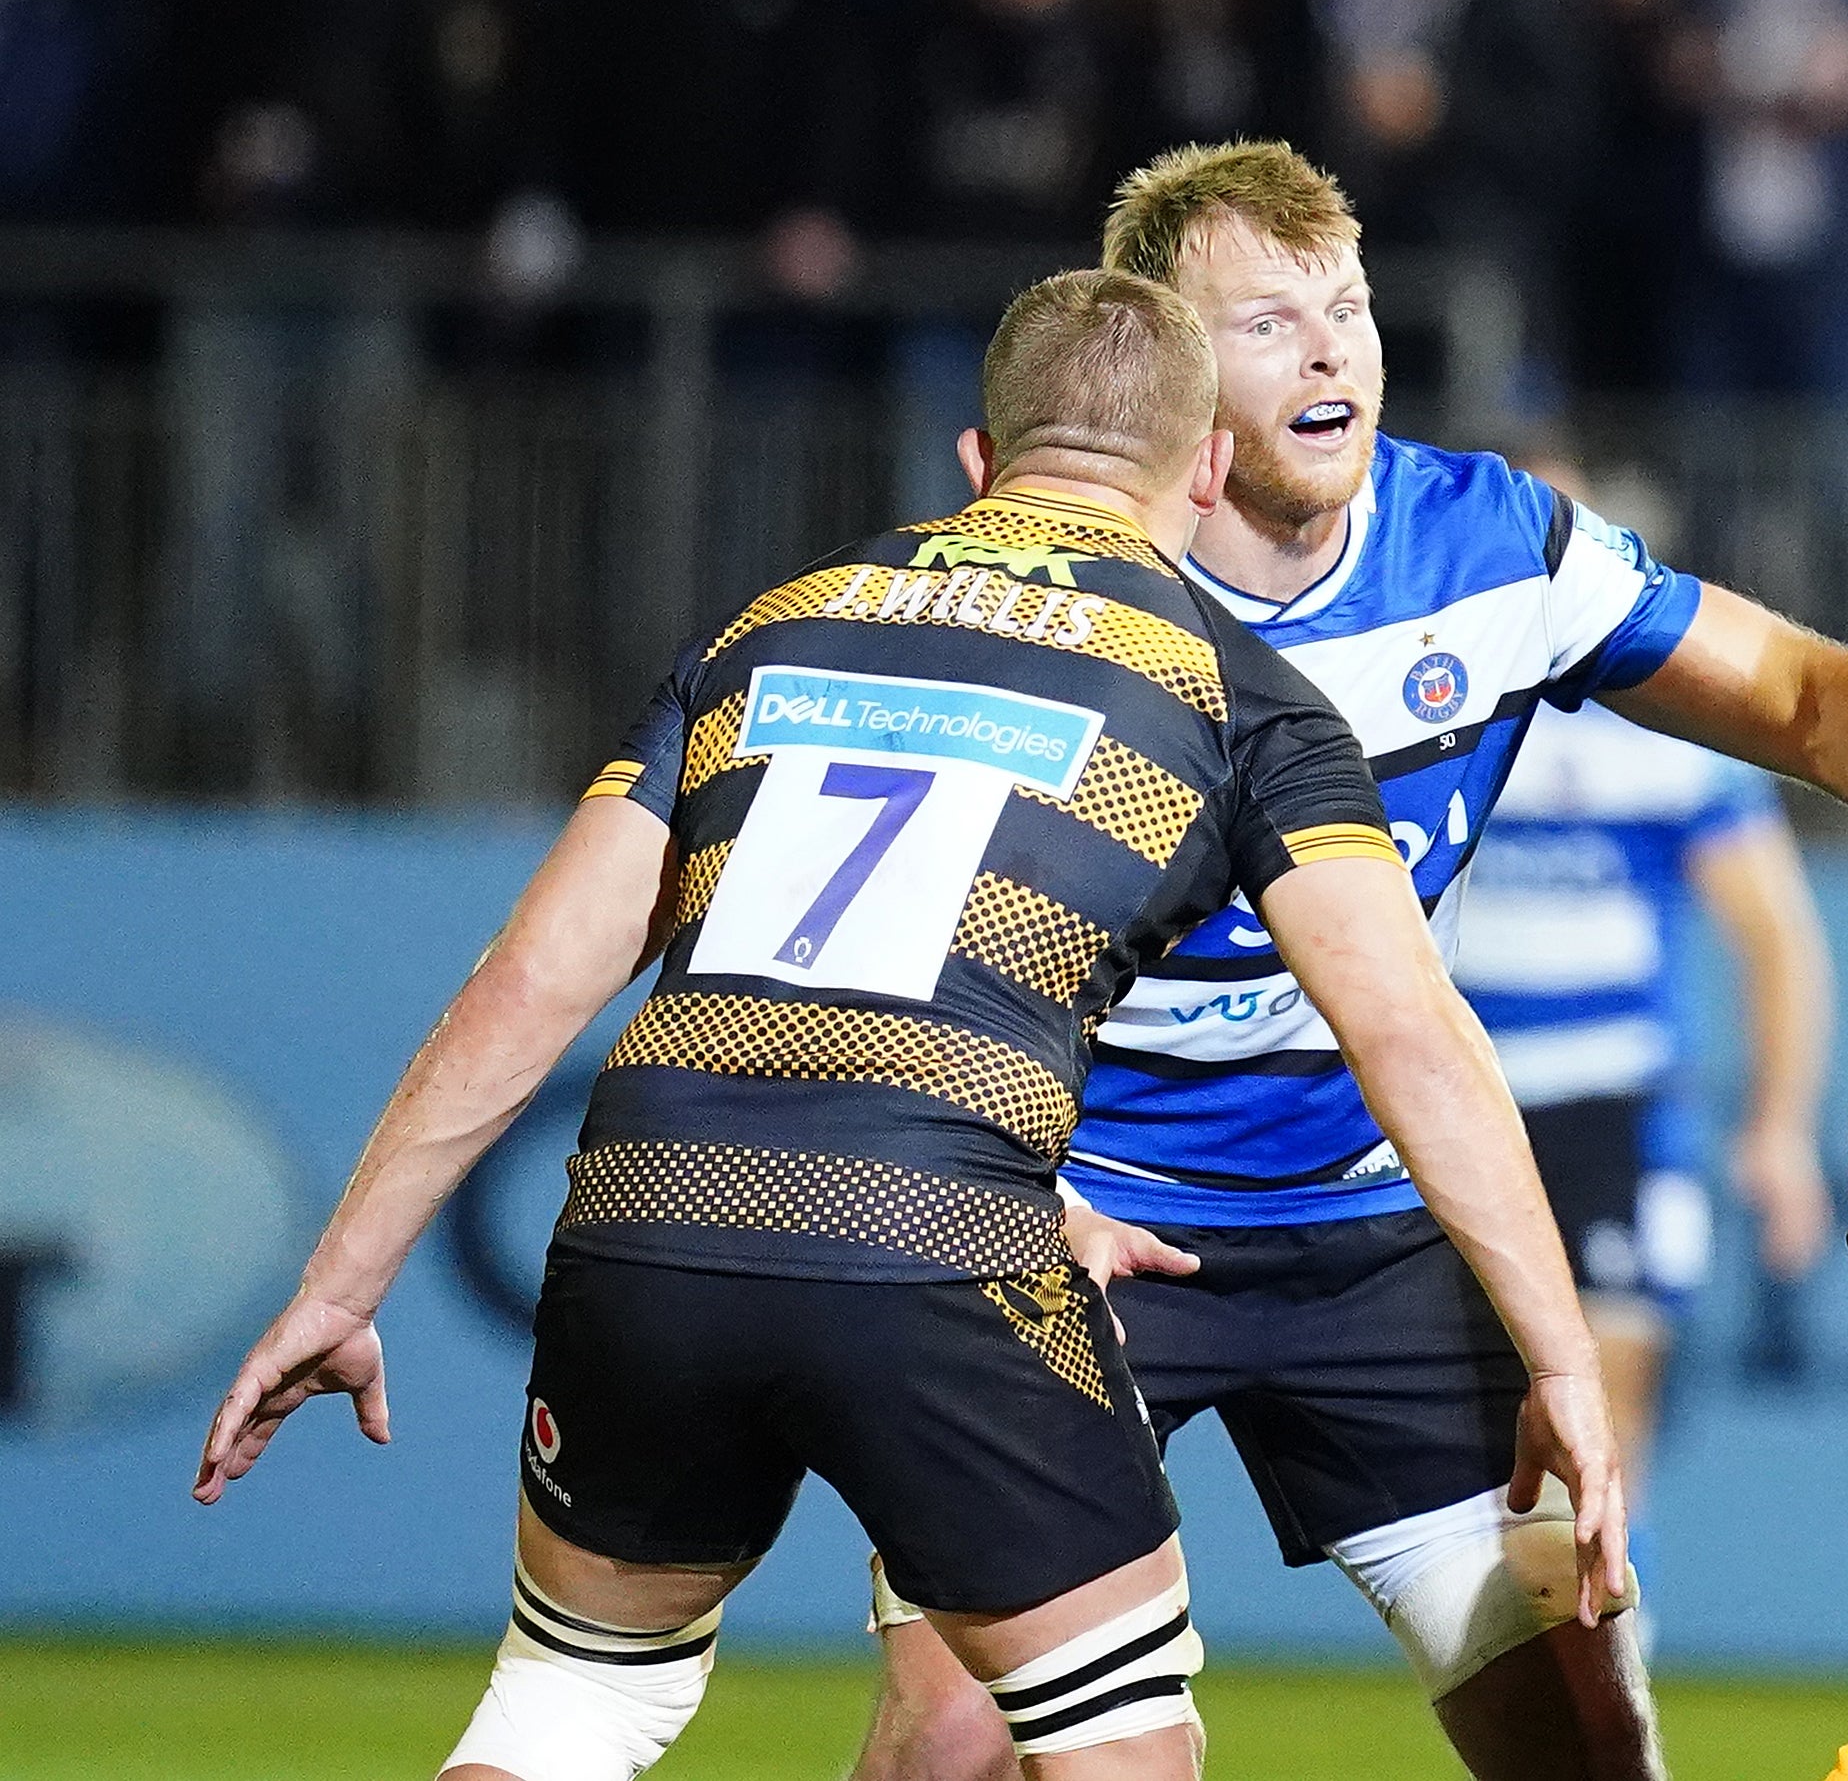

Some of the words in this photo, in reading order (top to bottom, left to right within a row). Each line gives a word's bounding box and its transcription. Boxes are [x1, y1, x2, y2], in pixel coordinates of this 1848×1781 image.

[757, 693, 851, 727] DELL
[856, 699, 1068, 763] Technologies
[772, 762, 937, 970] 7
